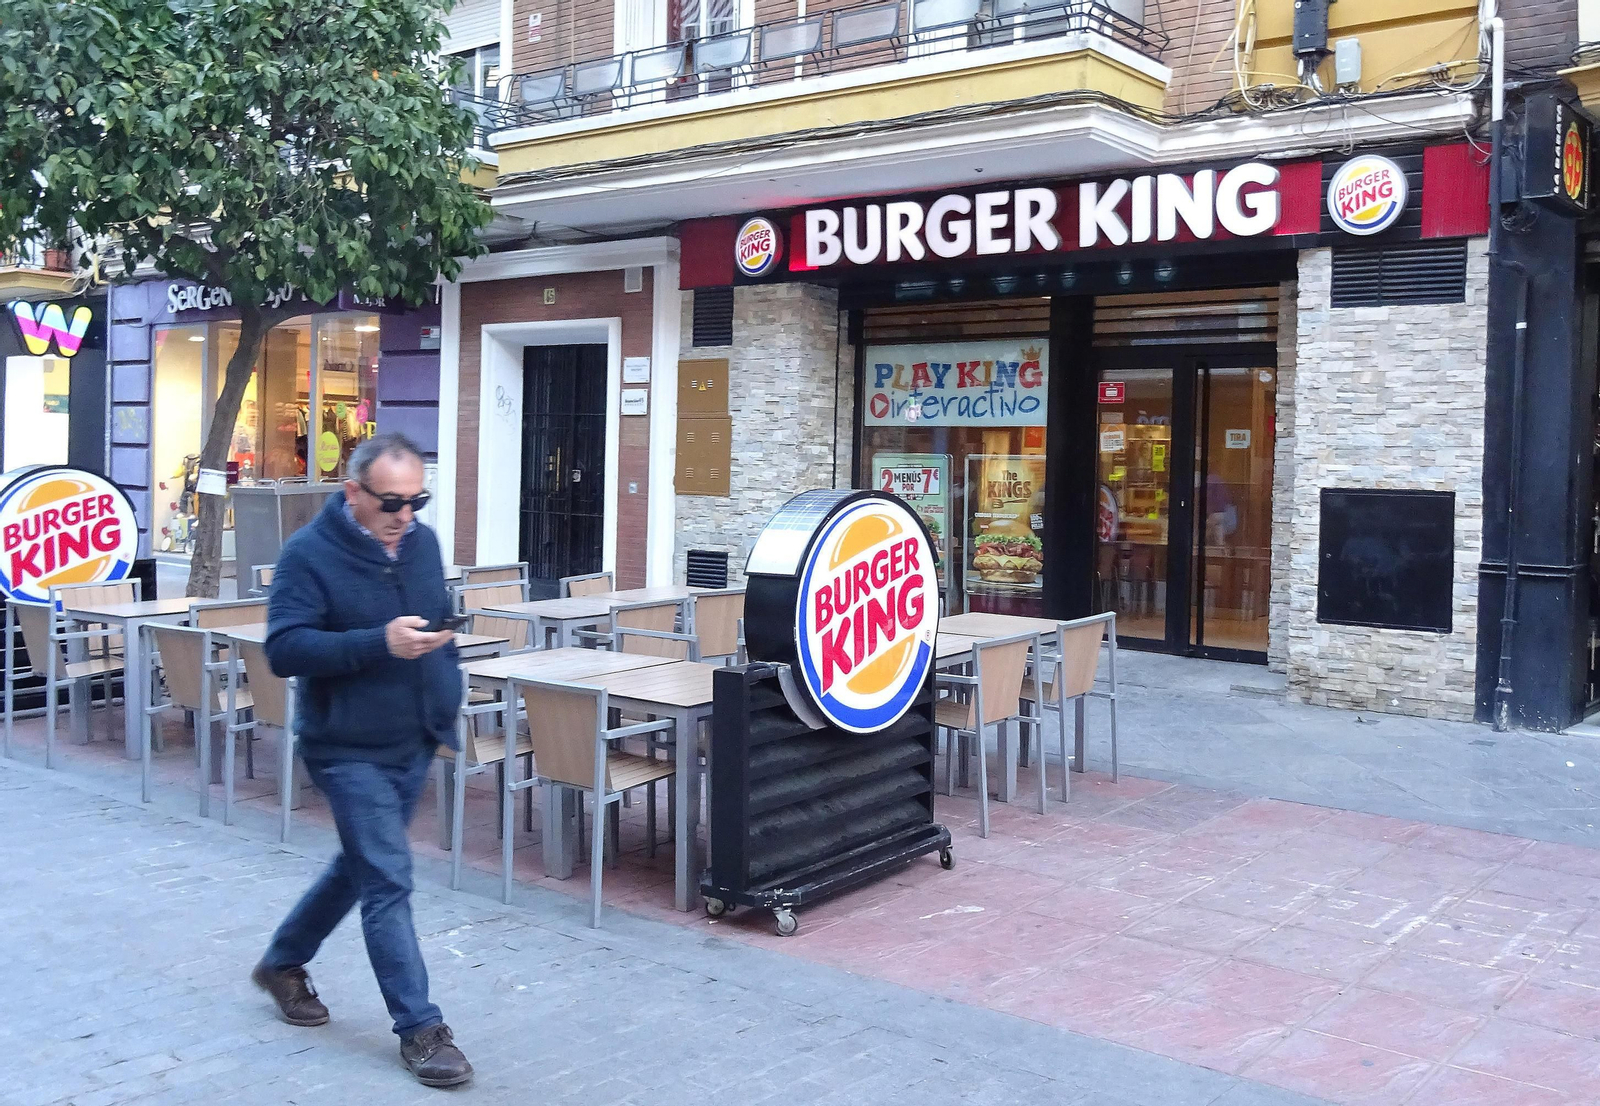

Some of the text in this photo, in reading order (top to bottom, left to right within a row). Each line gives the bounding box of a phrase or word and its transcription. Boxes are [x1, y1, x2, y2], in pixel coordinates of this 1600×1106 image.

[1339, 169, 1390, 201] BURGER
[1341, 180, 1393, 219] KING
[806, 162, 1280, 267] BURGER KING
[740, 230, 771, 249] BURGER
[740, 239, 771, 263] KING
[874, 360, 1043, 391] PLAY KING
[891, 381, 1040, 419] interactivo
[882, 469, 894, 493] 2
[894, 471, 921, 483] MENÚS
[988, 481, 1031, 498] KINGS
[1001, 470, 1018, 480] The
[3, 494, 115, 553] BURGER
[11, 517, 122, 589] KING
[815, 537, 920, 635] BURGER
[821, 574, 925, 693] KING
